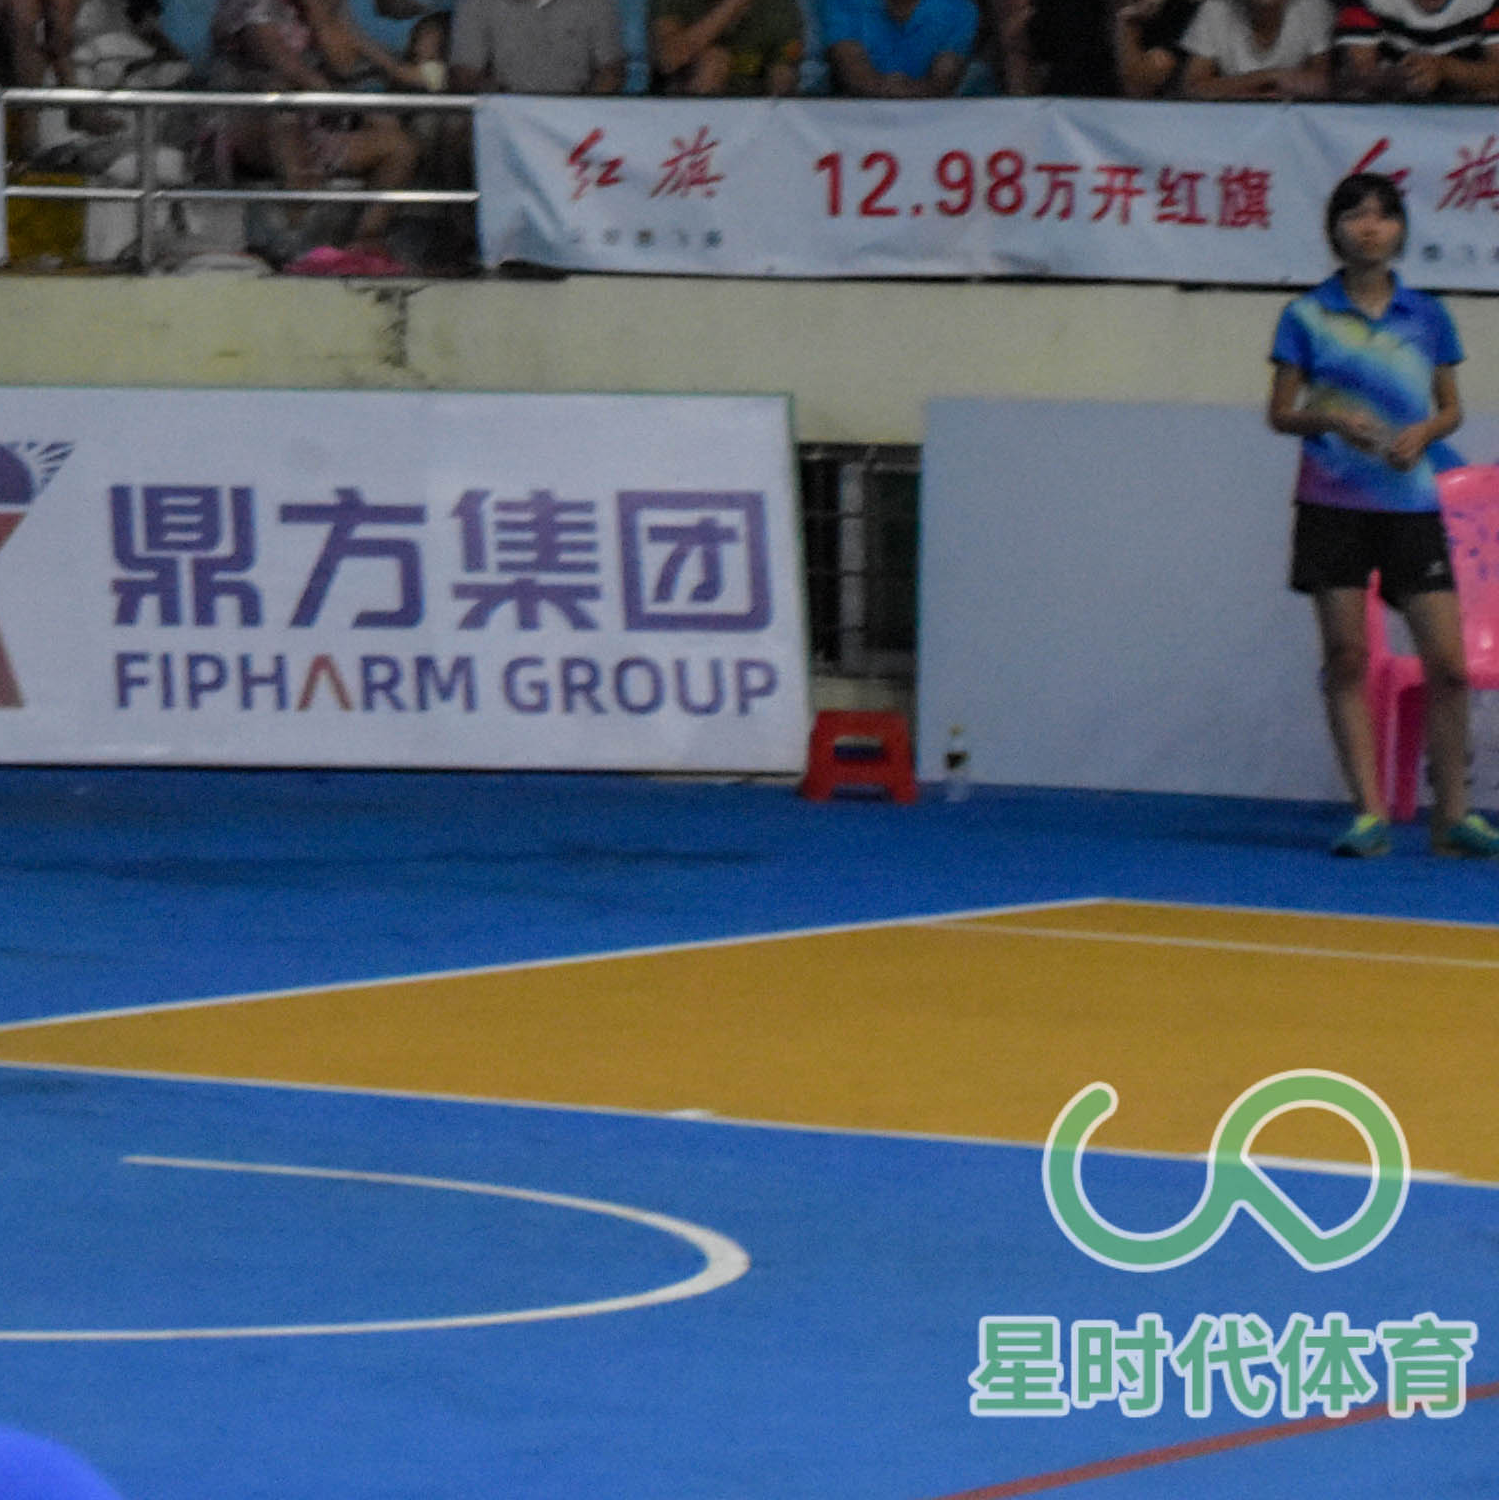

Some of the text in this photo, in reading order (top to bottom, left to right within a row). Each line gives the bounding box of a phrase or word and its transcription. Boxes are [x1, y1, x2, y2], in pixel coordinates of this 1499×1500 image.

[109, 484, 775, 633] 鼎方集团
[113, 649, 780, 719] FIPHARM GROUP
